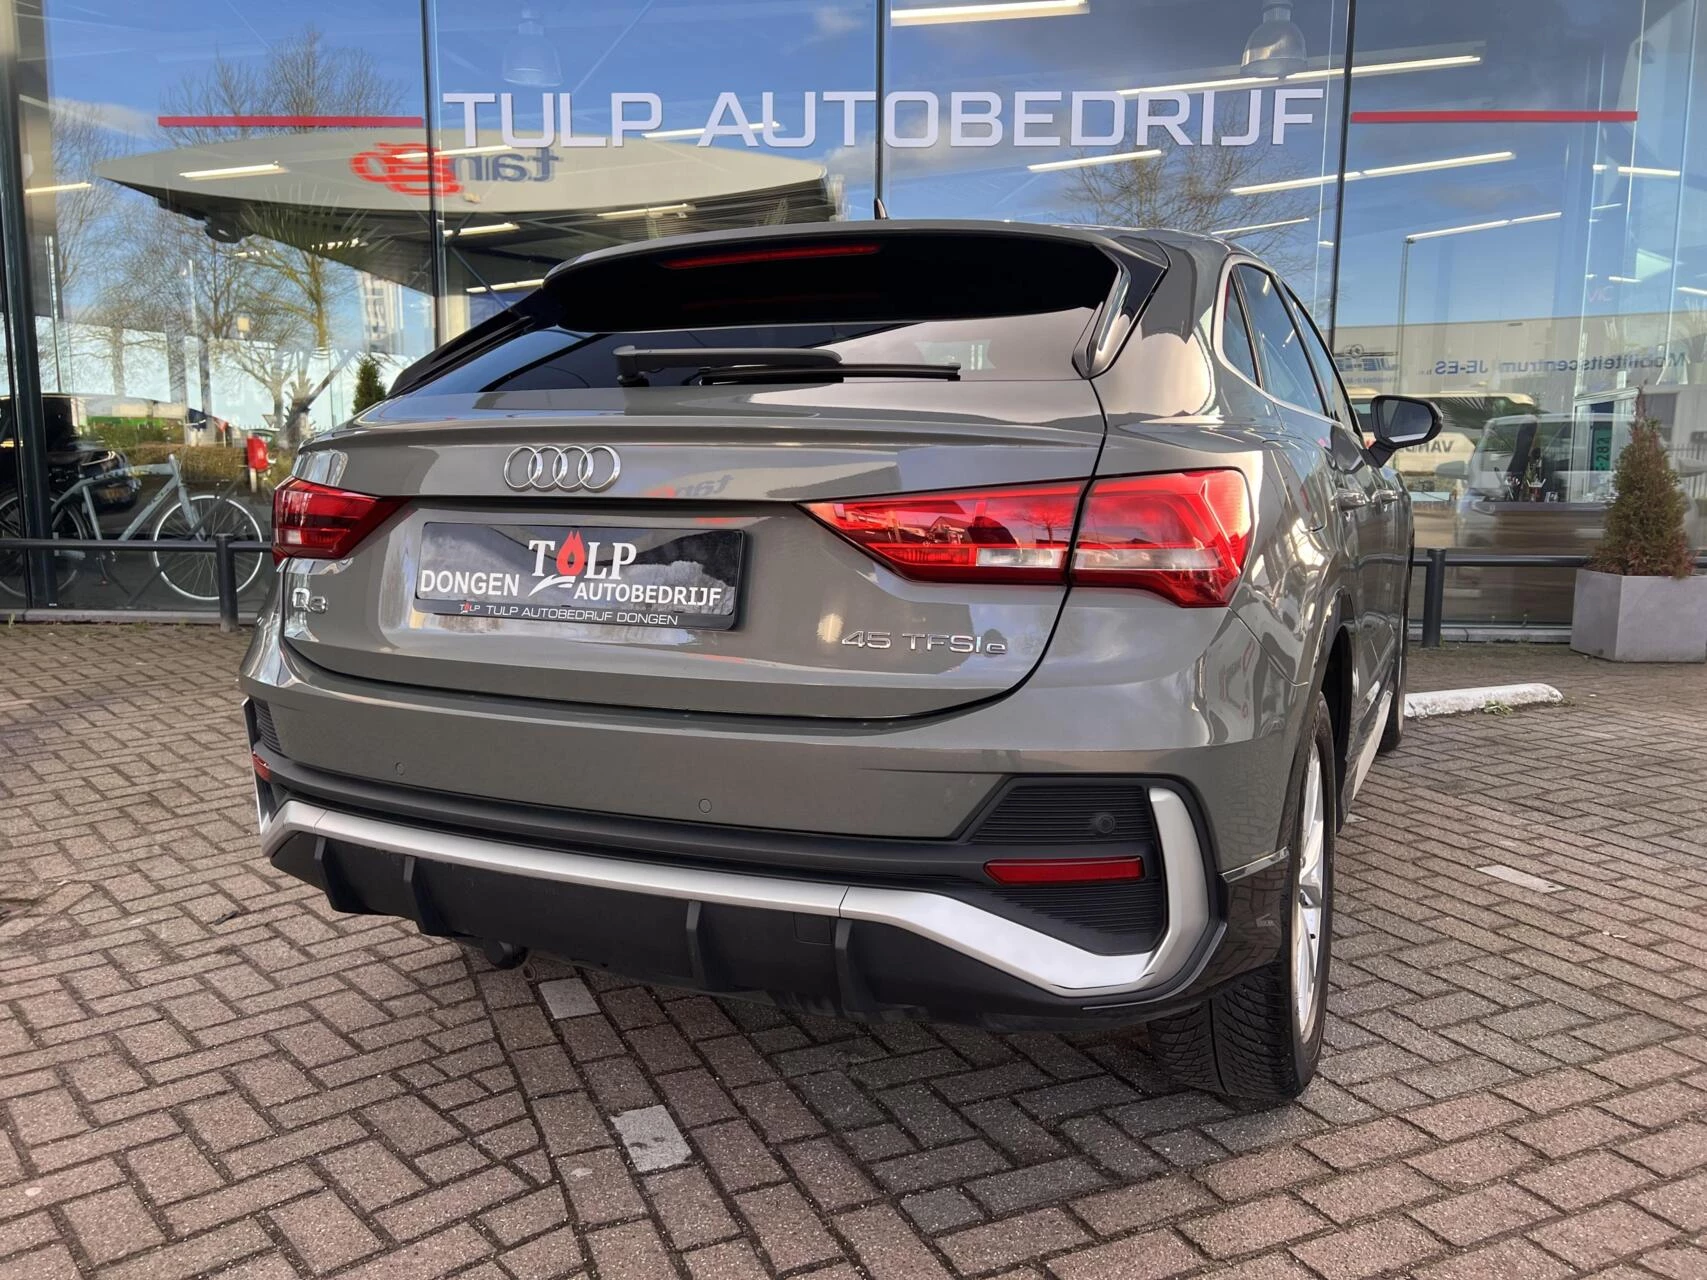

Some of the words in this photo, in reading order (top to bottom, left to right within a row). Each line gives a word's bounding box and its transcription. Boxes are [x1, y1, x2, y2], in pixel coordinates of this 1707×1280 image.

[443, 91, 663, 149] TULP
[697, 88, 1324, 148] AUTOBEDRIJF
[420, 569, 520, 597] DONGEN
[574, 582, 722, 607] AUTOBEDRIJF
[486, 605, 519, 616] TULP
[521, 607, 613, 622] AUTOBEDRIJF
[616, 612, 679, 626] DONGEN
[841, 630, 892, 649] 45
